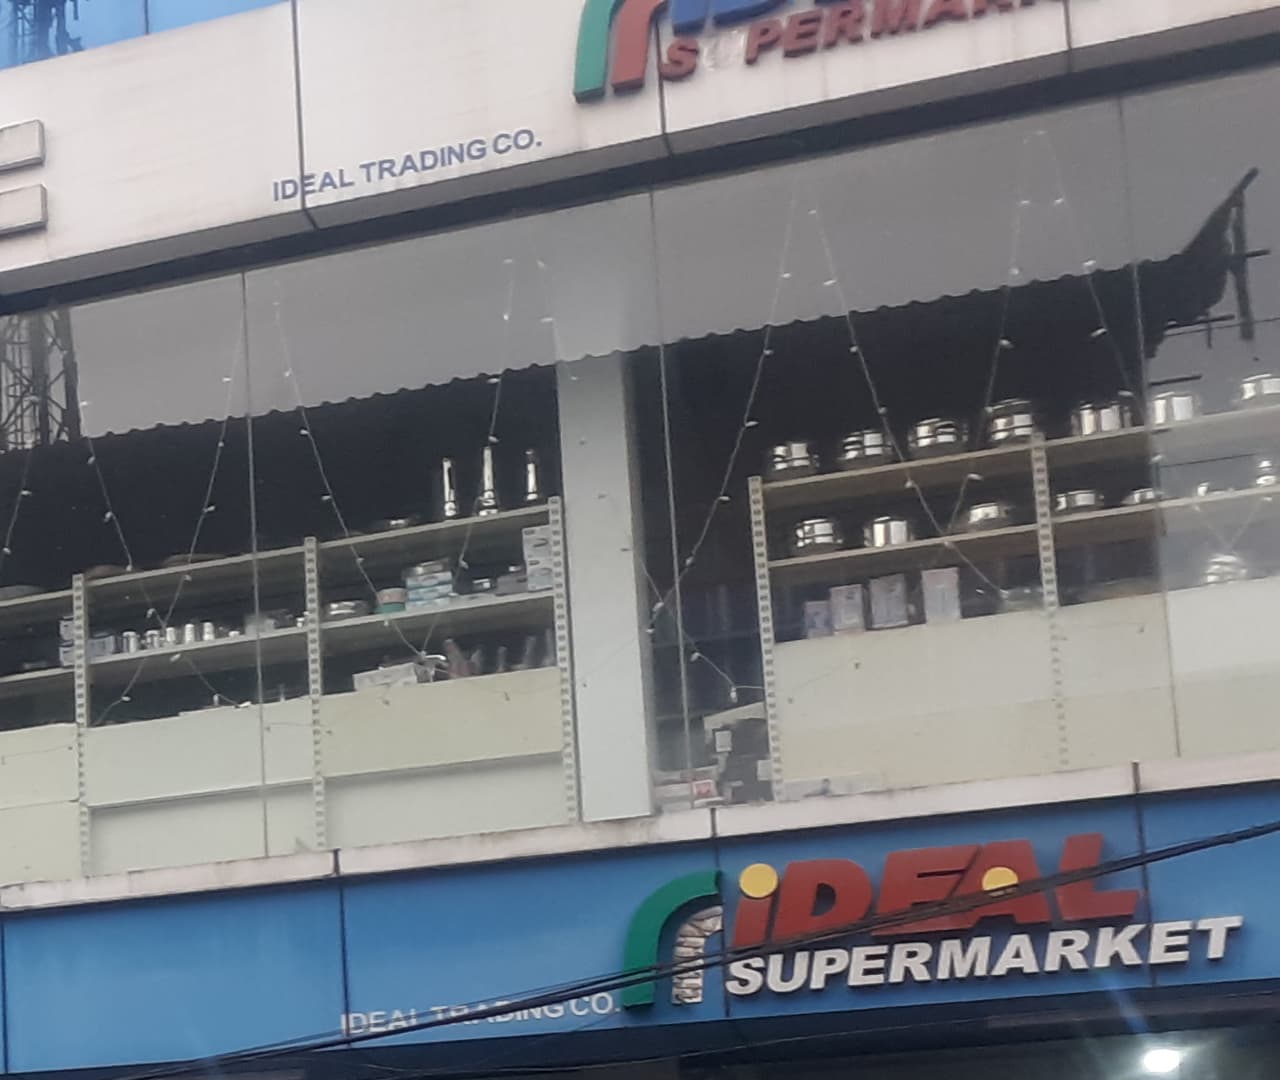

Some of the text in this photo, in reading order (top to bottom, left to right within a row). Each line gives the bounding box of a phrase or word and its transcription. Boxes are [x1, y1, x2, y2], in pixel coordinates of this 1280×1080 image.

[272, 128, 543, 201] IDEAL TRADING CO.
[724, 915, 1243, 997] SUPERMARKET
[569, 991, 622, 1017] CO.
